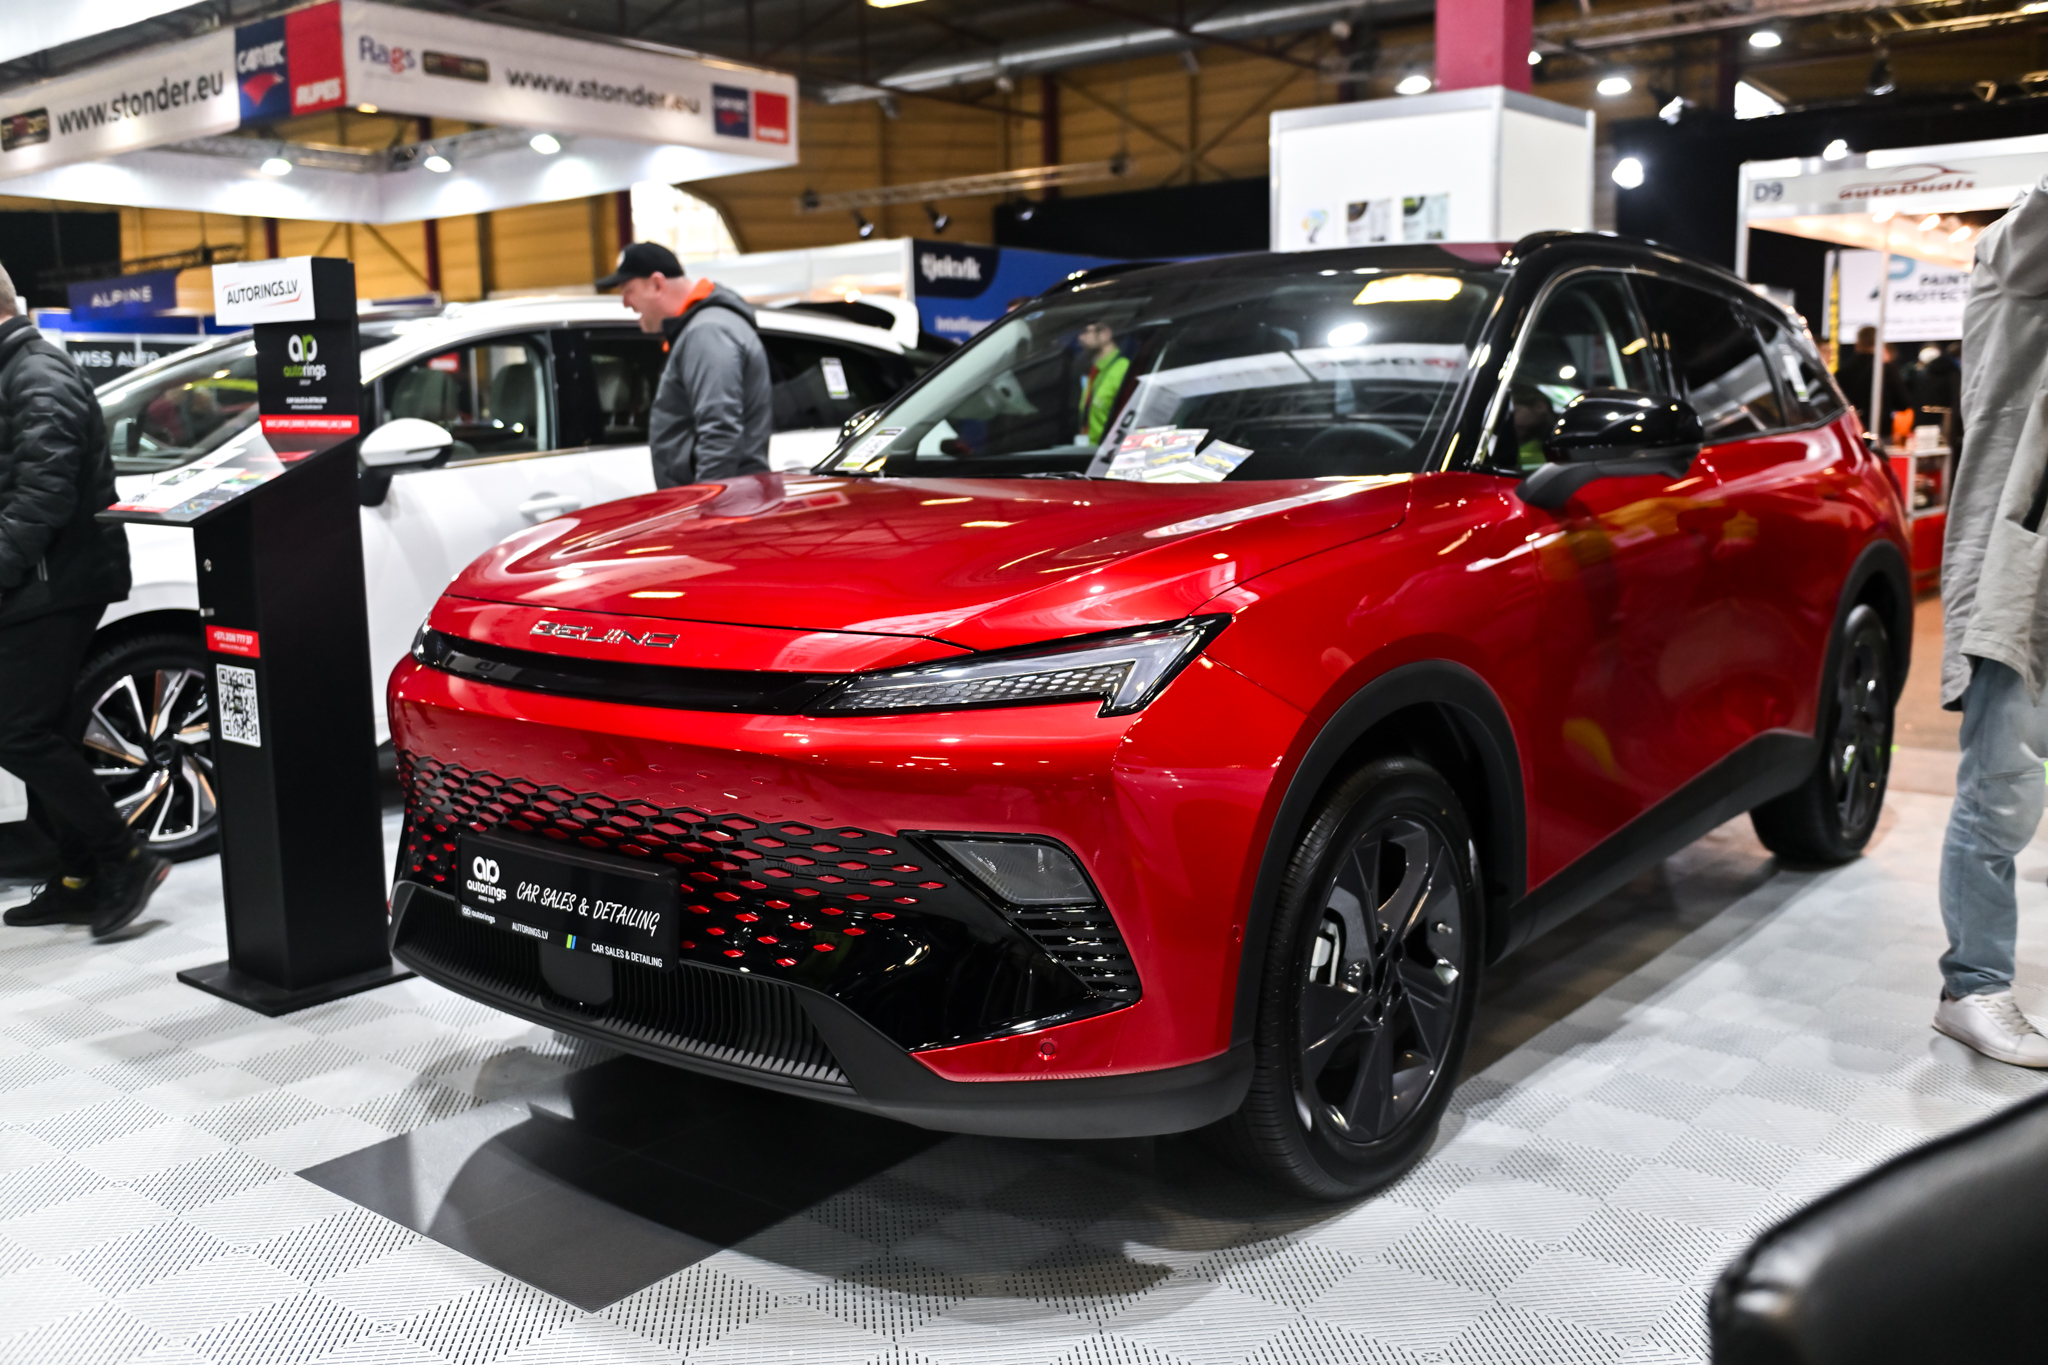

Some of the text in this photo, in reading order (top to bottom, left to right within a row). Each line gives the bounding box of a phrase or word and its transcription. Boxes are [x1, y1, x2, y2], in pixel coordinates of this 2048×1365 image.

[505, 67, 700, 114] www.stonder.eu
[57, 70, 224, 135] www.stonder.eu
[1754, 181, 1784, 202] D9
[1920, 272, 1970, 286] PAINT
[91, 285, 152, 308] ALPINE
[227, 279, 298, 305] AUTORINGS.LV
[1895, 289, 1969, 302] PROTECT
[73, 350, 113, 367] VISS
[283, 363, 327, 381] autorings
[466, 879, 507, 902] autorings
[471, 909, 496, 924] autorings
[516, 881, 660, 938] CAR SALES & DETAILING
[512, 922, 548, 939] AUTORINGS.LV
[591, 943, 662, 968] CAR SALES & DETAILING
